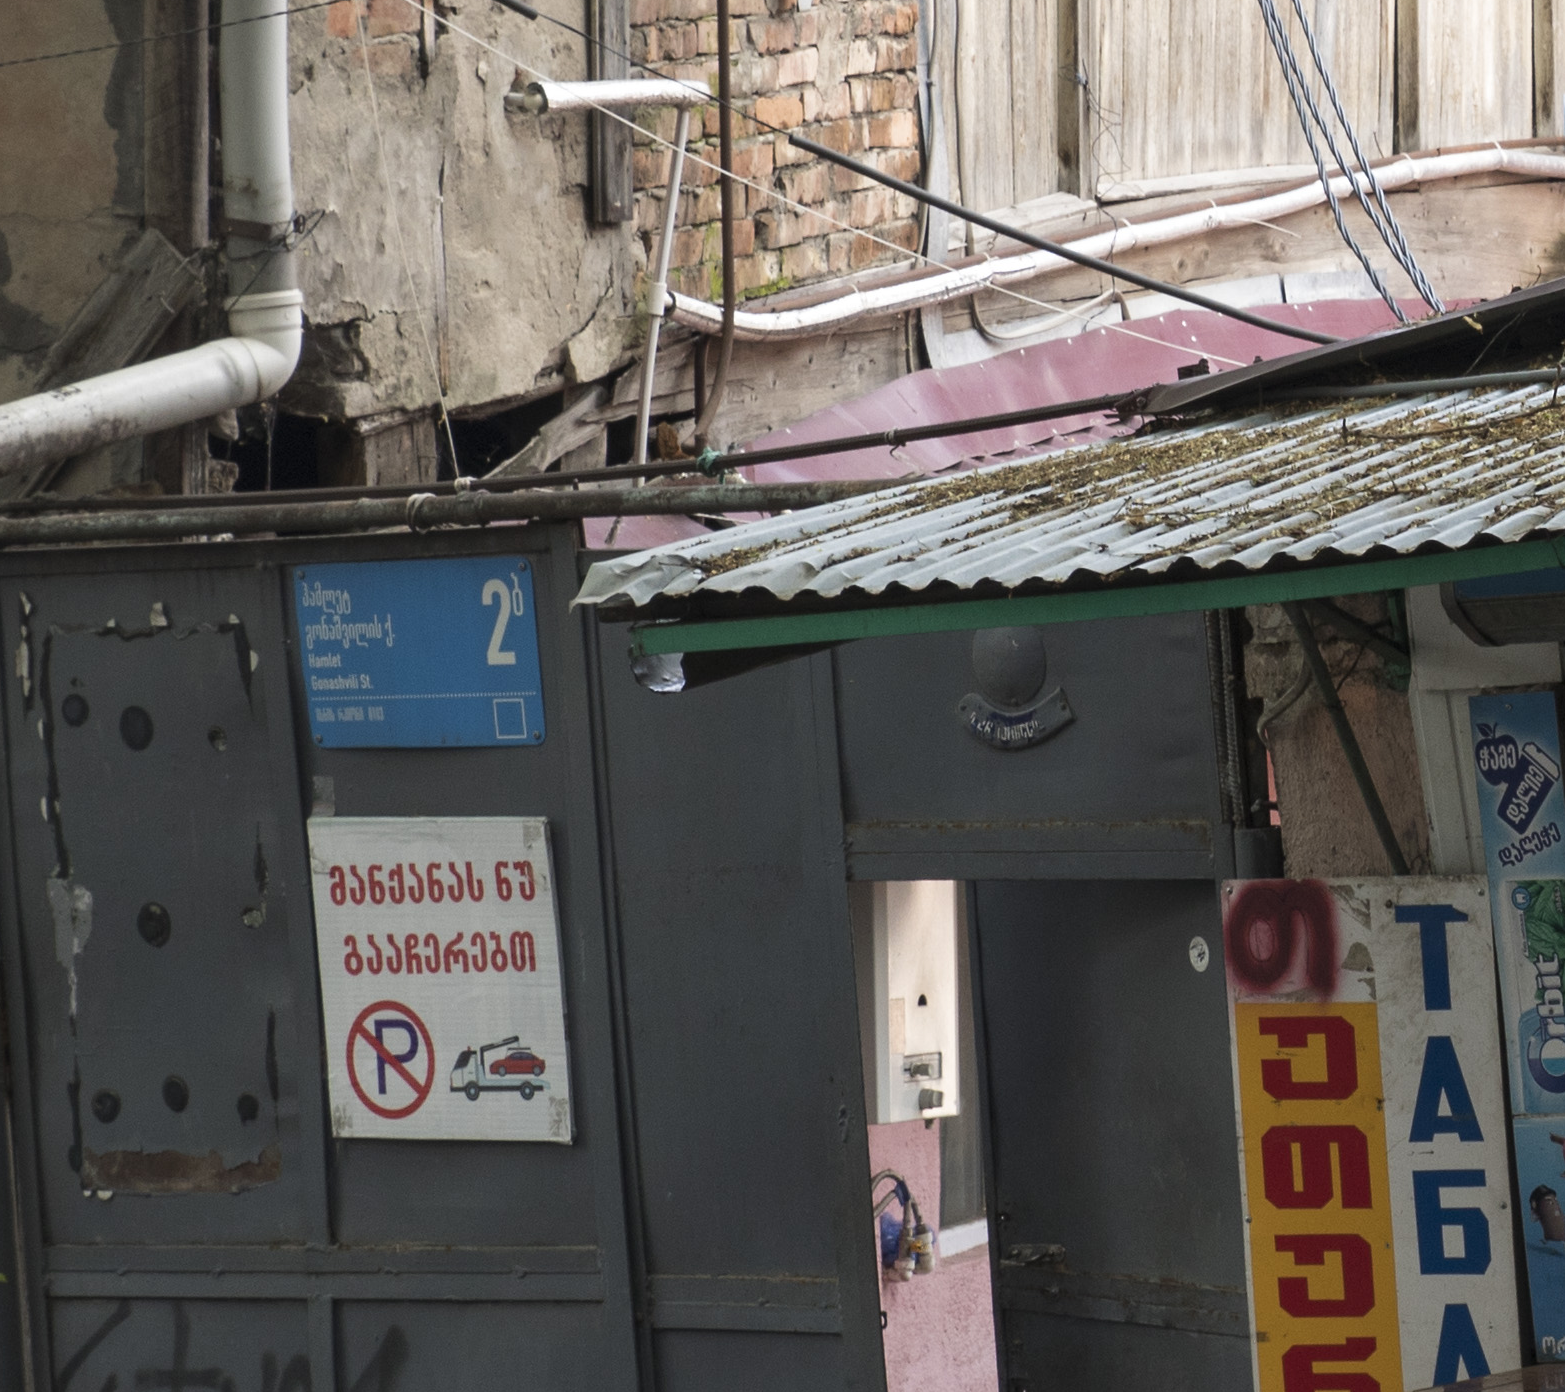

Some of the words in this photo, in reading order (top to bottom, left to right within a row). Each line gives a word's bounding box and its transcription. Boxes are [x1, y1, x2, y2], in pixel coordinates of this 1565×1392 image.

[308, 653, 342, 669] Hamlet
[311, 674, 359, 691] Gonashvili
[360, 674, 374, 690] St.
[1479, 744, 1517, 771] ჭამე
[1506, 765, 1545, 825] დალიე
[1498, 821, 1561, 868] დაღეჭე
[330, 861, 484, 906] მანქანას
[494, 860, 536, 903] ნუ
[343, 929, 536, 976] გააჩერებთ
[374, 1018, 419, 1095] P
